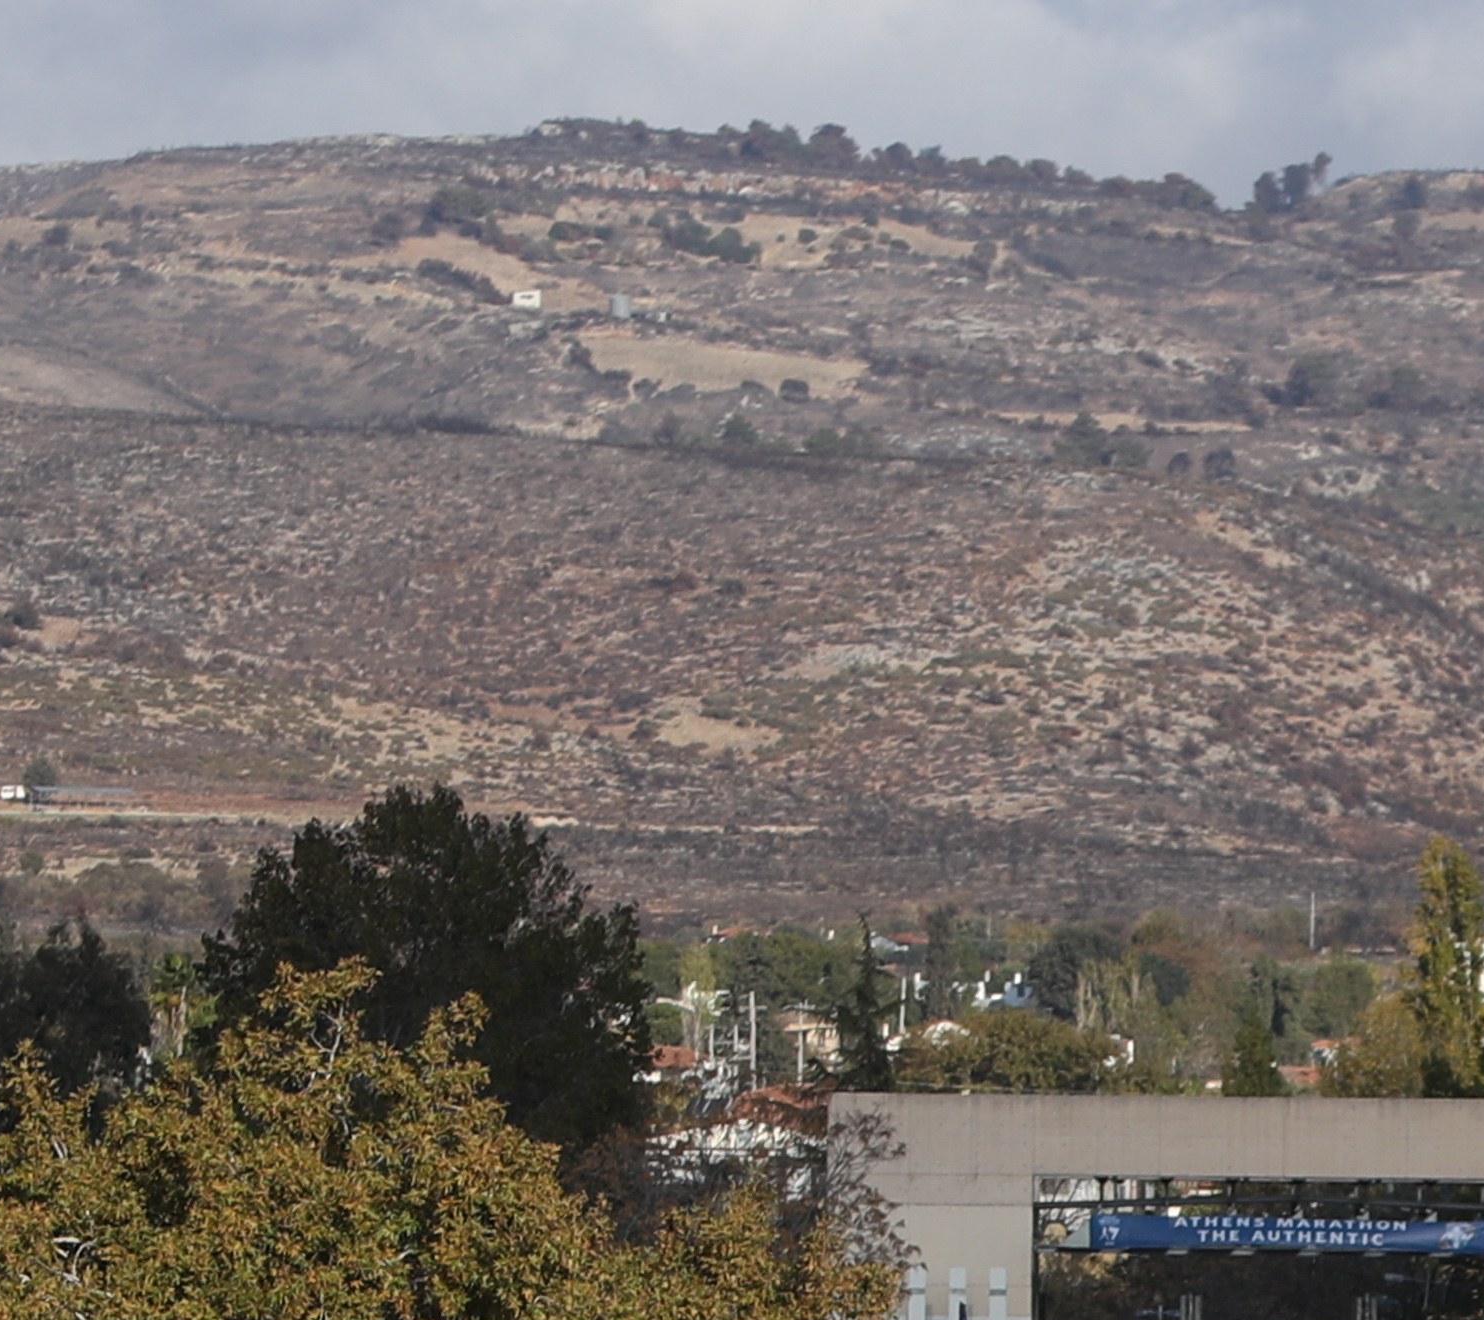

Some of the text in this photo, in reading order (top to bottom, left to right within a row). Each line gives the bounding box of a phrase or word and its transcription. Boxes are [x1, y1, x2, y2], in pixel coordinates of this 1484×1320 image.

[1174, 1216, 1407, 1231] ATHENS MARATHON
[1197, 1229, 1384, 1246] THE AUTHENTIC
